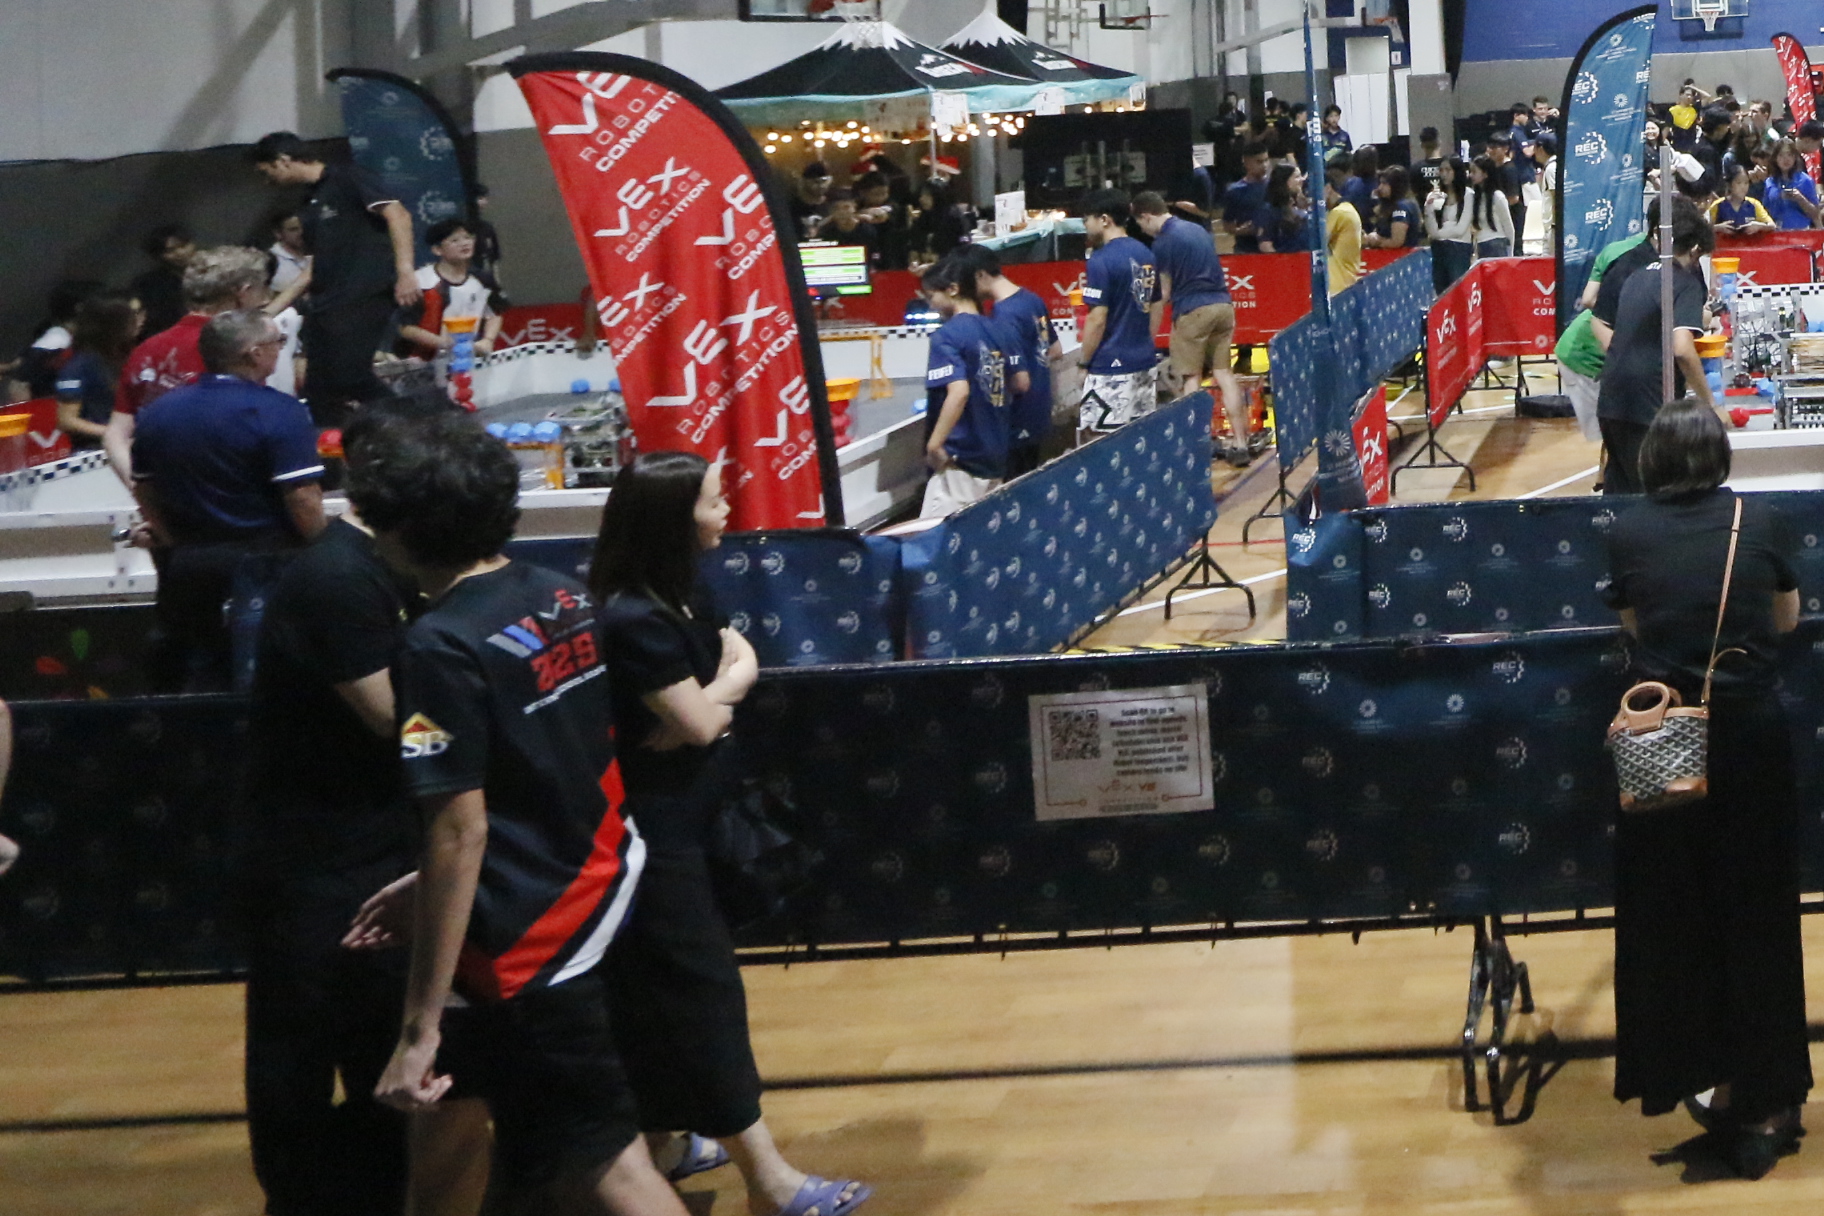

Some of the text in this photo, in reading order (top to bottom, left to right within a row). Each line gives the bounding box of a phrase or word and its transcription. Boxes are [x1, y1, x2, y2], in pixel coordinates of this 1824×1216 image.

[548, 71, 632, 135] VE
[1575, 141, 1599, 155] REC
[594, 156, 691, 237] VEX
[625, 178, 712, 262] COMPETITION
[694, 174, 765, 245] VE
[1585, 207, 1609, 220] REC
[597, 271, 665, 327] EX
[498, 318, 575, 346] VEX
[645, 289, 778, 406] VEX
[753, 375, 810, 446] VE
[538, 589, 593, 621] VEX
[1493, 661, 1517, 672] REC
